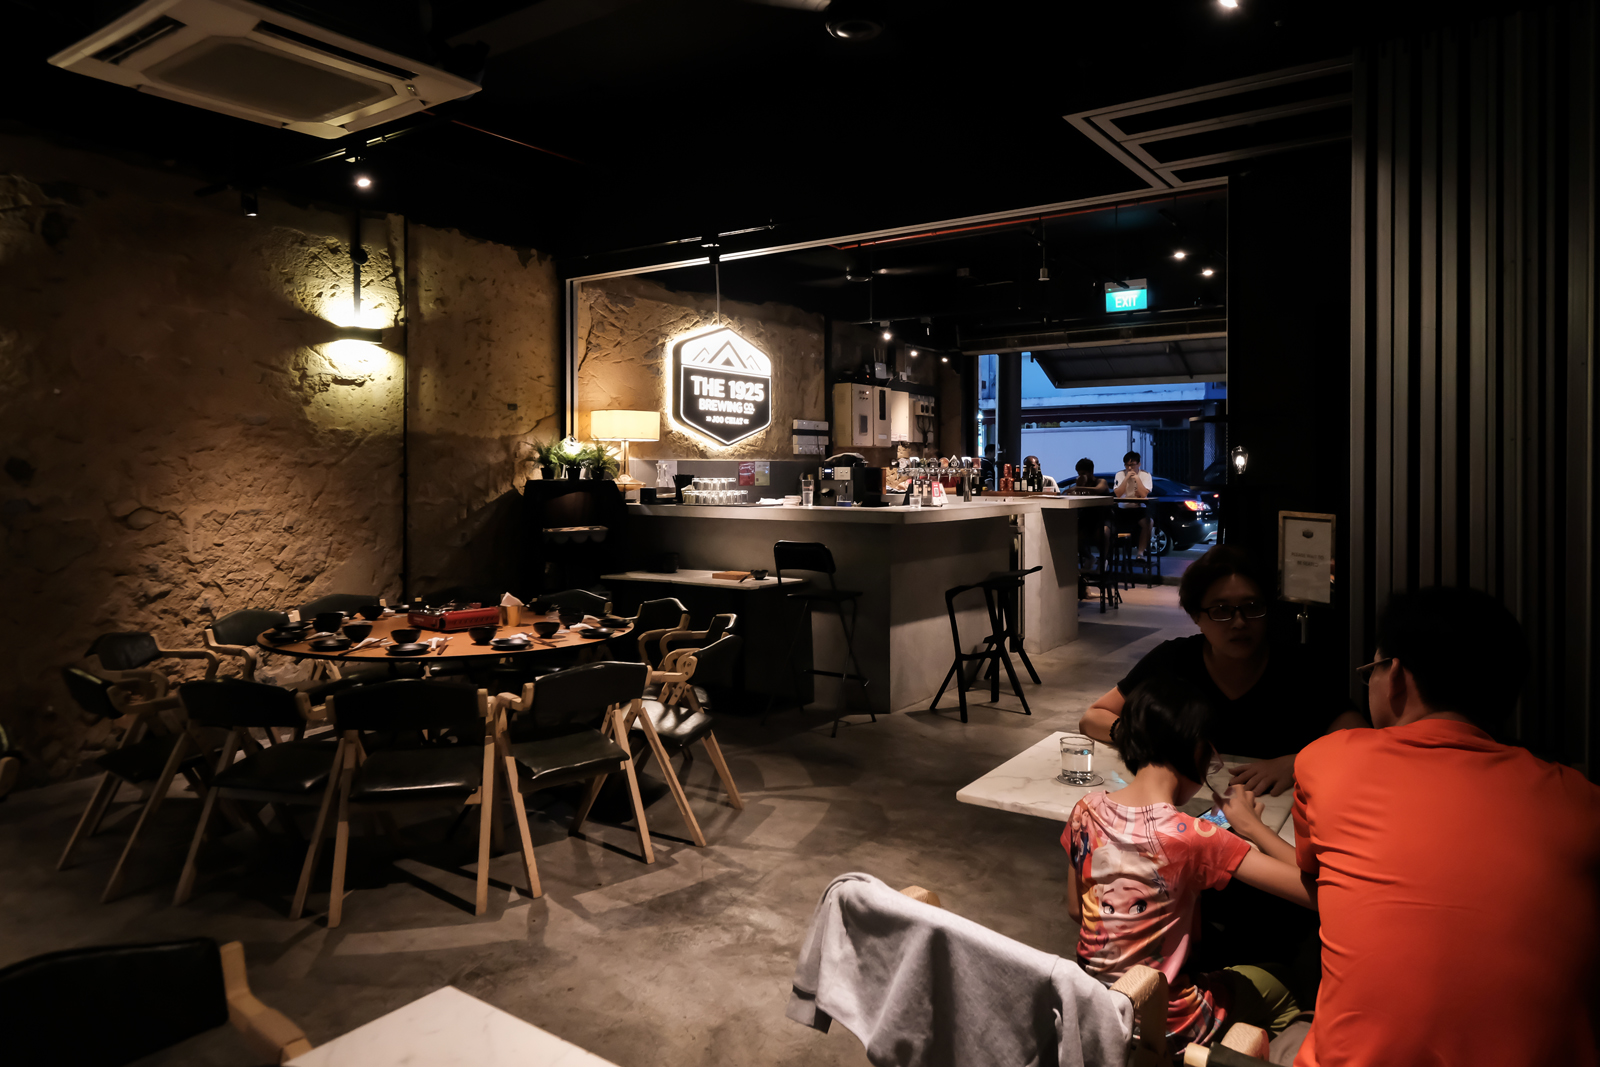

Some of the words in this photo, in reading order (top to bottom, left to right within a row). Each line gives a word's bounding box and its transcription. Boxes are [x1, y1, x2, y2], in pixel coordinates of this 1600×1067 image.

[1115, 295, 1137, 308] EXIT
[690, 375, 725, 398] THE
[728, 380, 765, 402] 1925
[698, 398, 743, 413] BREWING
[711, 415, 724, 424] JOO
